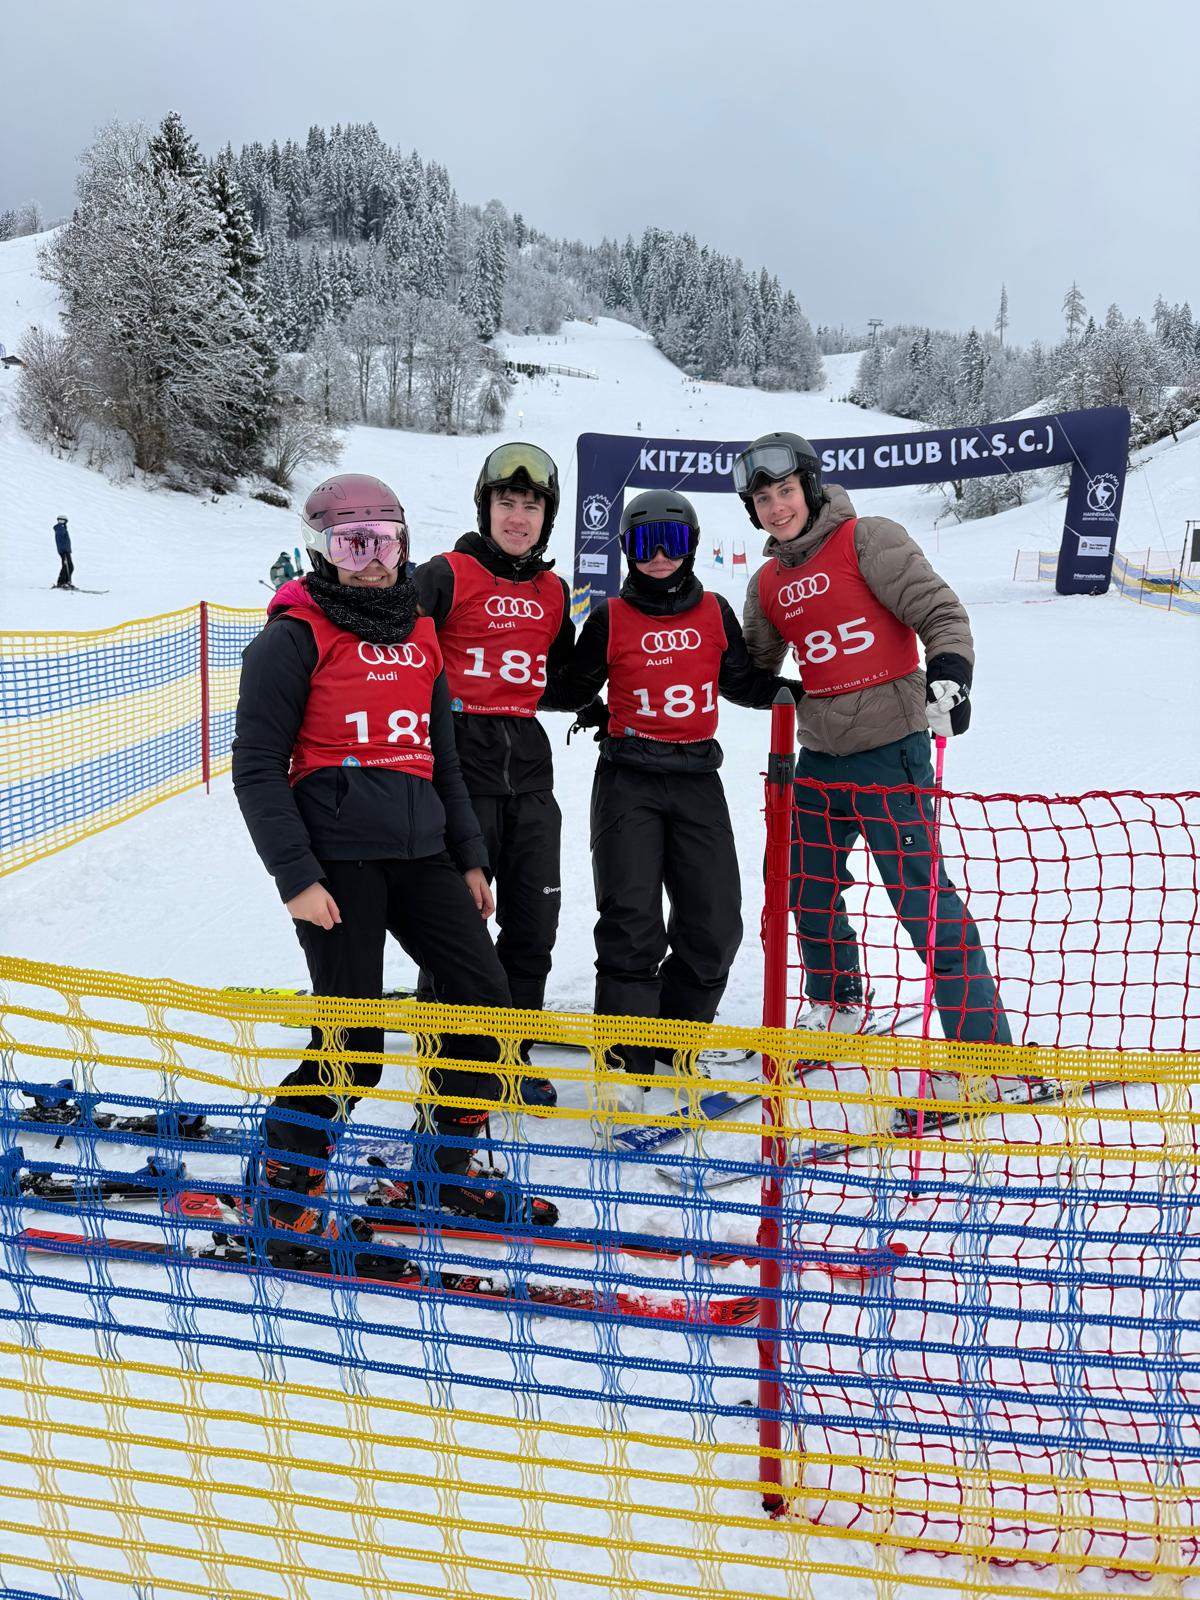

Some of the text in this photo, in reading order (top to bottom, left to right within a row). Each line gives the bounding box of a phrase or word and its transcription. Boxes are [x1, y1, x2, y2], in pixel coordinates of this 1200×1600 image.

[640, 449, 741, 475] KITZBÜ
[821, 448, 865, 472] SKI
[873, 441, 942, 468] CLUB
[951, 425, 1054, 466] (K.S.C.)
[784, 606, 804, 620] Audi
[487, 620, 516, 629] Audi
[646, 656, 673, 667] Audi
[366, 671, 398, 681] Audi
[843, 679, 862, 689] CLUB
[632, 681, 716, 718] 181
